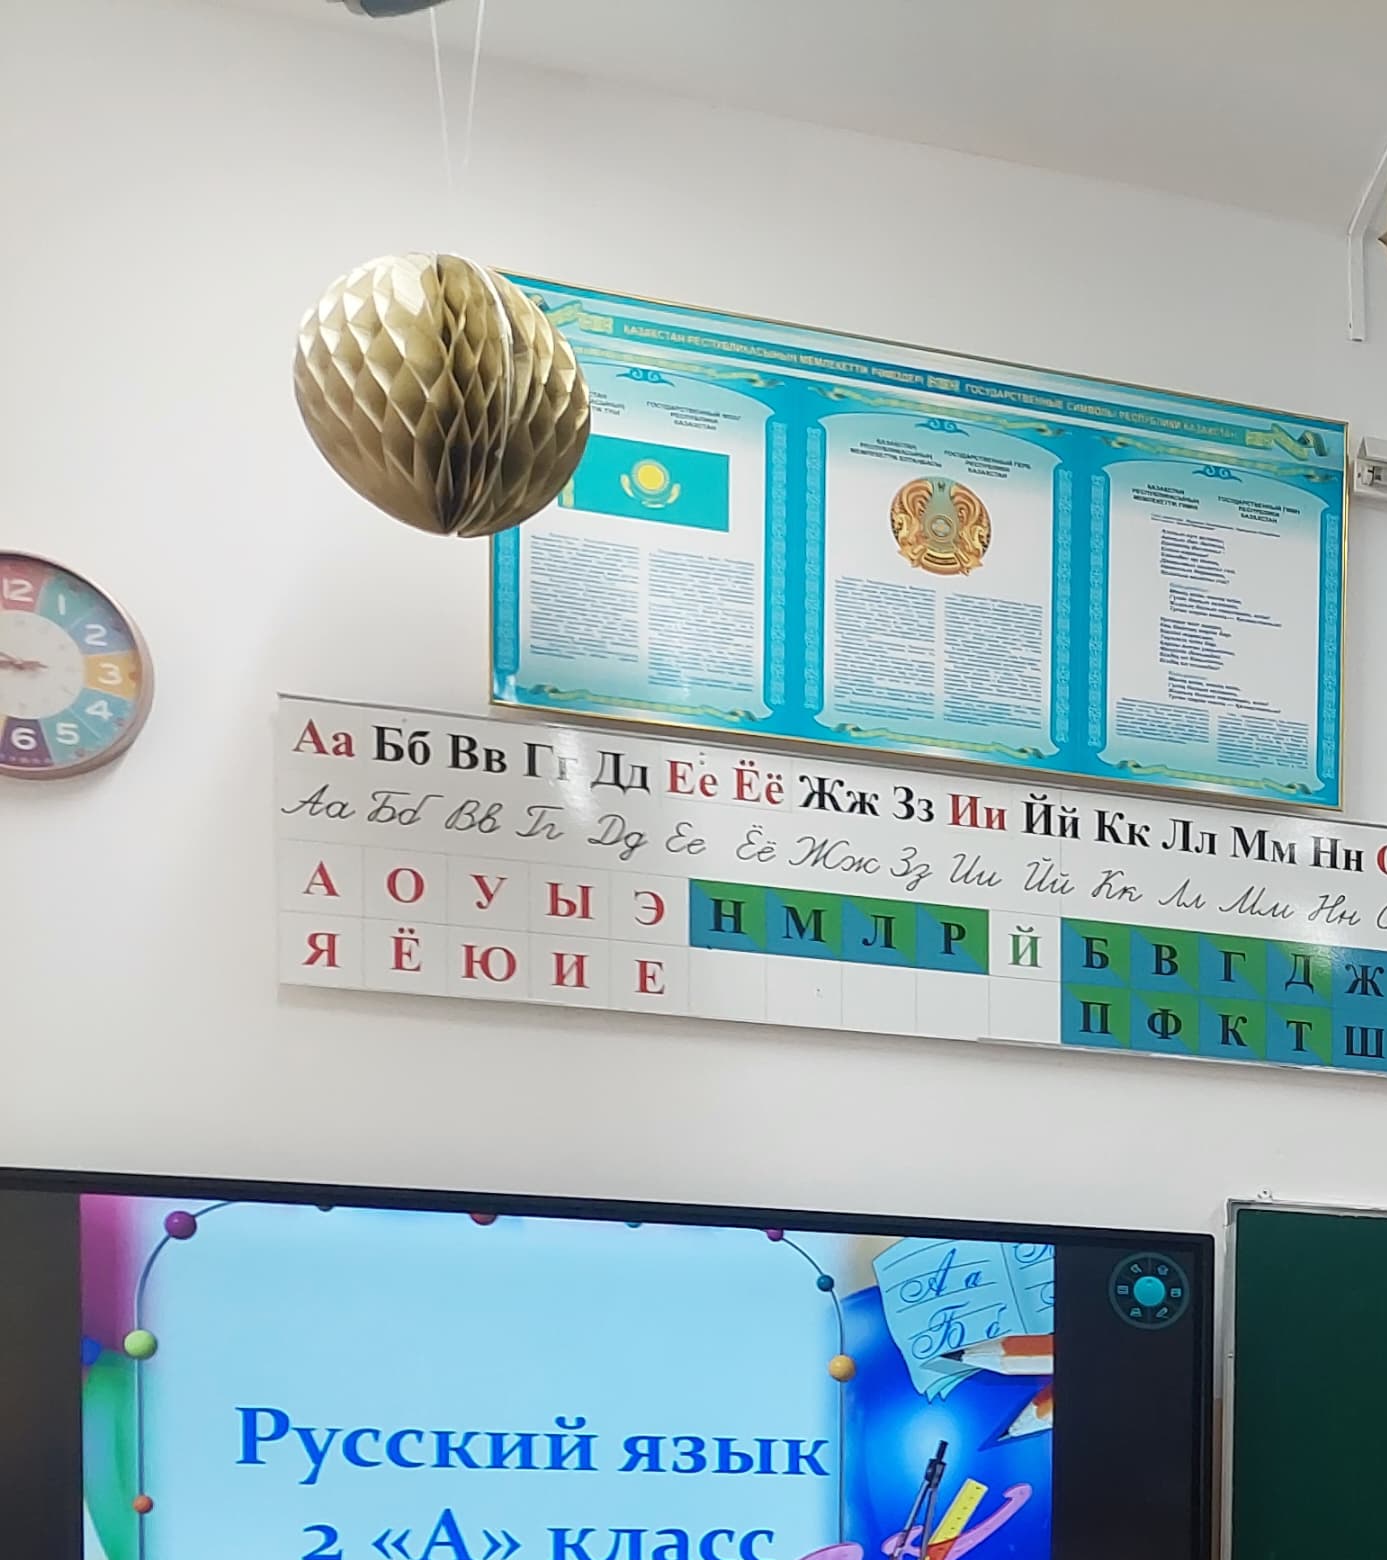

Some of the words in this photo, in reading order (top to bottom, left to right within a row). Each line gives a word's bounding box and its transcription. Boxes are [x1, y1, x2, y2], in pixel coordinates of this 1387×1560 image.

[3, 579, 33, 601] 12
[59, 594, 65, 615] 1
[85, 625, 107, 646] 2
[99, 663, 121, 685] 3
[86, 700, 113, 720] 4
[11, 727, 37, 750] 6
[56, 723, 79, 744] 5
[293, 718, 356, 758] Аа
[371, 725, 431, 766] Бб
[448, 733, 508, 774] Вв
[523, 742, 578, 782] Гг
[591, 751, 651, 795] Дд
[665, 759, 719, 798] Ее
[732, 760, 785, 805] Ёё
[799, 775, 880, 818] Жж
[892, 785, 935, 823] Зз
[948, 793, 1007, 831] Ии
[1022, 792, 1080, 840] Йй
[1095, 809, 1151, 849] Кк
[1162, 818, 1217, 856] Лл
[1230, 825, 1297, 866] Мм
[1309, 836, 1364, 873] Нн
[303, 861, 340, 897] А
[386, 867, 425, 904] О
[470, 874, 508, 910] У
[545, 882, 594, 920] Ы
[633, 890, 665, 926] Э
[302, 932, 340, 968] Я
[391, 927, 422, 972] Ё
[461, 943, 517, 983] Ю
[551, 951, 591, 989] И
[635, 959, 666, 995] Е
[235, 1407, 598, 1486] Русский
[618, 1434, 830, 1477] язык
